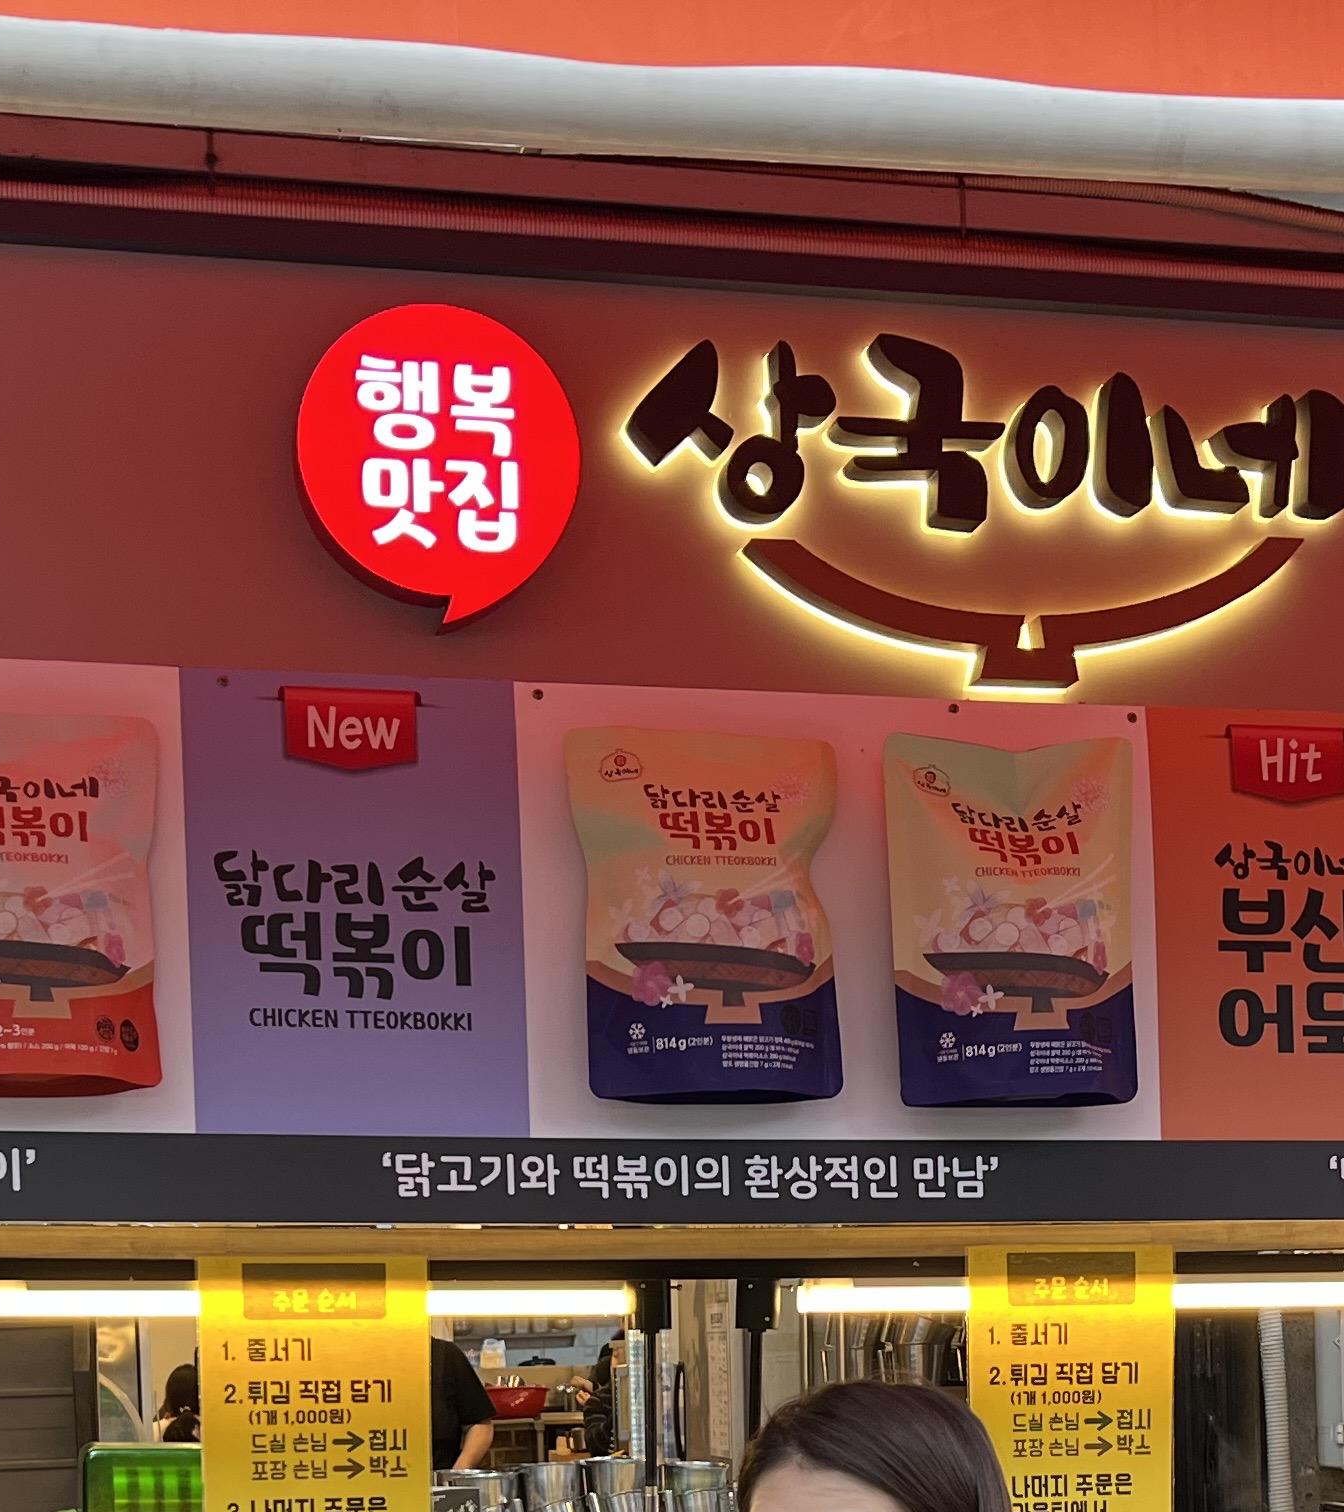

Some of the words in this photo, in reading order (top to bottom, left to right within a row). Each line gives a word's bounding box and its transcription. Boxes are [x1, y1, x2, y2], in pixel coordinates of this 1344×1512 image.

[355, 354, 517, 456] 행복
[361, 455, 520, 553] 맛집
[305, 704, 401, 752] New
[1258, 737, 1323, 786] Hit
[659, 810, 777, 851] 떡볶이
[968, 827, 1080, 867] 떡볶이
[665, 855, 711, 867] CHICKEN
[714, 855, 778, 867] TTEOKBOKKI
[975, 866, 1018, 878] CHICKEN
[240, 911, 474, 1001] 떡볶이
[248, 1006, 339, 1029] CHICKEN
[344, 1009, 473, 1032] TTEOKBOKKI
[571, 1153, 730, 1200] 떡볶이의
[743, 1153, 898, 1201] 환상적인
[272, 1289, 309, 1313] 주문
[1033, 1277, 1068, 1300] 주문
[988, 1325, 1001, 1346] 1.
[1010, 1322, 1069, 1346] 줄서기
[222, 1340, 236, 1361] 1.
[247, 1338, 312, 1362] 줄서기
[1010, 1363, 1048, 1387] 튀김
[1055, 1362, 1093, 1386] 직접
[1101, 1361, 1139, 1385] 담기
[247, 1380, 290, 1405] 튀김
[299, 1380, 342, 1404] 직접
[350, 1379, 392, 1403] 담기
[1010, 1391, 1037, 1406] (1개
[1041, 1389, 1102, 1406] 1,000원)
[248, 1410, 277, 1425] (1개
[283, 1408, 352, 1425] 1,000원)
[1013, 1412, 1044, 1433] 드실
[1049, 1412, 1080, 1432] 손님
[1117, 1408, 1152, 1431] 접시
[251, 1433, 286, 1454] 드실
[292, 1432, 327, 1453] 손님
[368, 1428, 407, 1452] 접시
[1013, 1438, 1044, 1458] 포장
[1049, 1438, 1080, 1457] 손님
[1116, 1434, 1152, 1456] 박스
[251, 1460, 287, 1481] 포장
[292, 1459, 328, 1480] 손님
[369, 1455, 408, 1478] 박스
[1011, 1474, 1069, 1499] 나머지
[1075, 1473, 1133, 1497] 주문은
